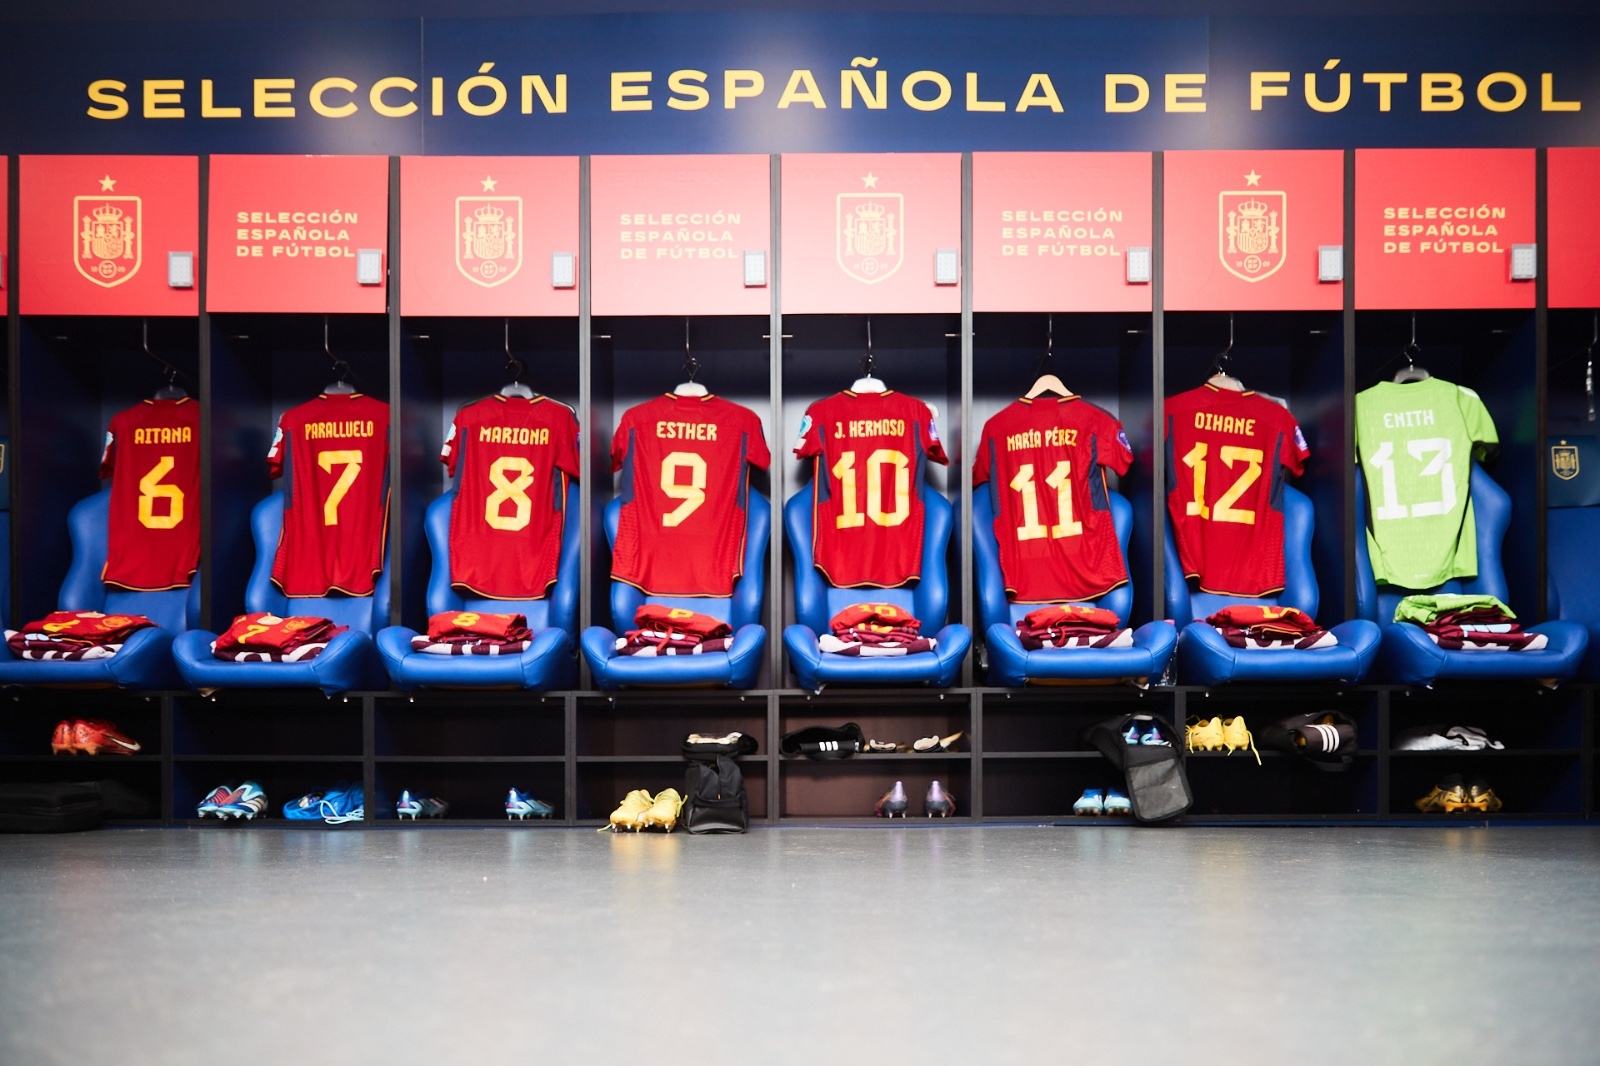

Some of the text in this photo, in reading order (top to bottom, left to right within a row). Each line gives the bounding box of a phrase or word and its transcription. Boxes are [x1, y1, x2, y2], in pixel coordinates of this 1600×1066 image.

[87, 57, 1582, 120] SELECCIÓN ESPAÑOLA DE FÚTBOL
[237, 210, 358, 223] SELECCIÓN
[620, 210, 741, 225] SELECCIÓN
[1002, 208, 1123, 222] SELECCIÓN
[1384, 205, 1506, 219] SELECCIÓN
[237, 226, 349, 241] ESPAÑOLA
[620, 228, 733, 242] ESPAÑOLA
[1002, 225, 1115, 239] ESPAÑOLA
[1384, 222, 1498, 236] ESPAÑOLA
[237, 243, 355, 257] DE FÚTBOL
[620, 245, 739, 259] DE FÚTBOL
[1002, 241, 1121, 256] DE FÚTBOL
[1384, 238, 1504, 253] DE FÚTBOL
[834, 418, 906, 439] J. HERMOSO
[1194, 411, 1256, 437] OIHANE
[1383, 409, 1436, 429] ENITH
[134, 426, 192, 445] AITANA
[304, 420, 374, 440] PARALLUELO
[479, 426, 550, 446] MARIONA
[656, 420, 718, 441] ESTHER
[1006, 427, 1079, 452] MARÍA PÉREZ
[317, 449, 363, 527] 7
[660, 451, 707, 527] 9
[831, 449, 910, 529] 10
[1182, 441, 1264, 525] 12
[1369, 437, 1457, 521] 13
[138, 455, 185, 529] 6
[484, 456, 534, 531] 8
[1009, 460, 1083, 542] 11
[237, 624, 270, 644] 7
